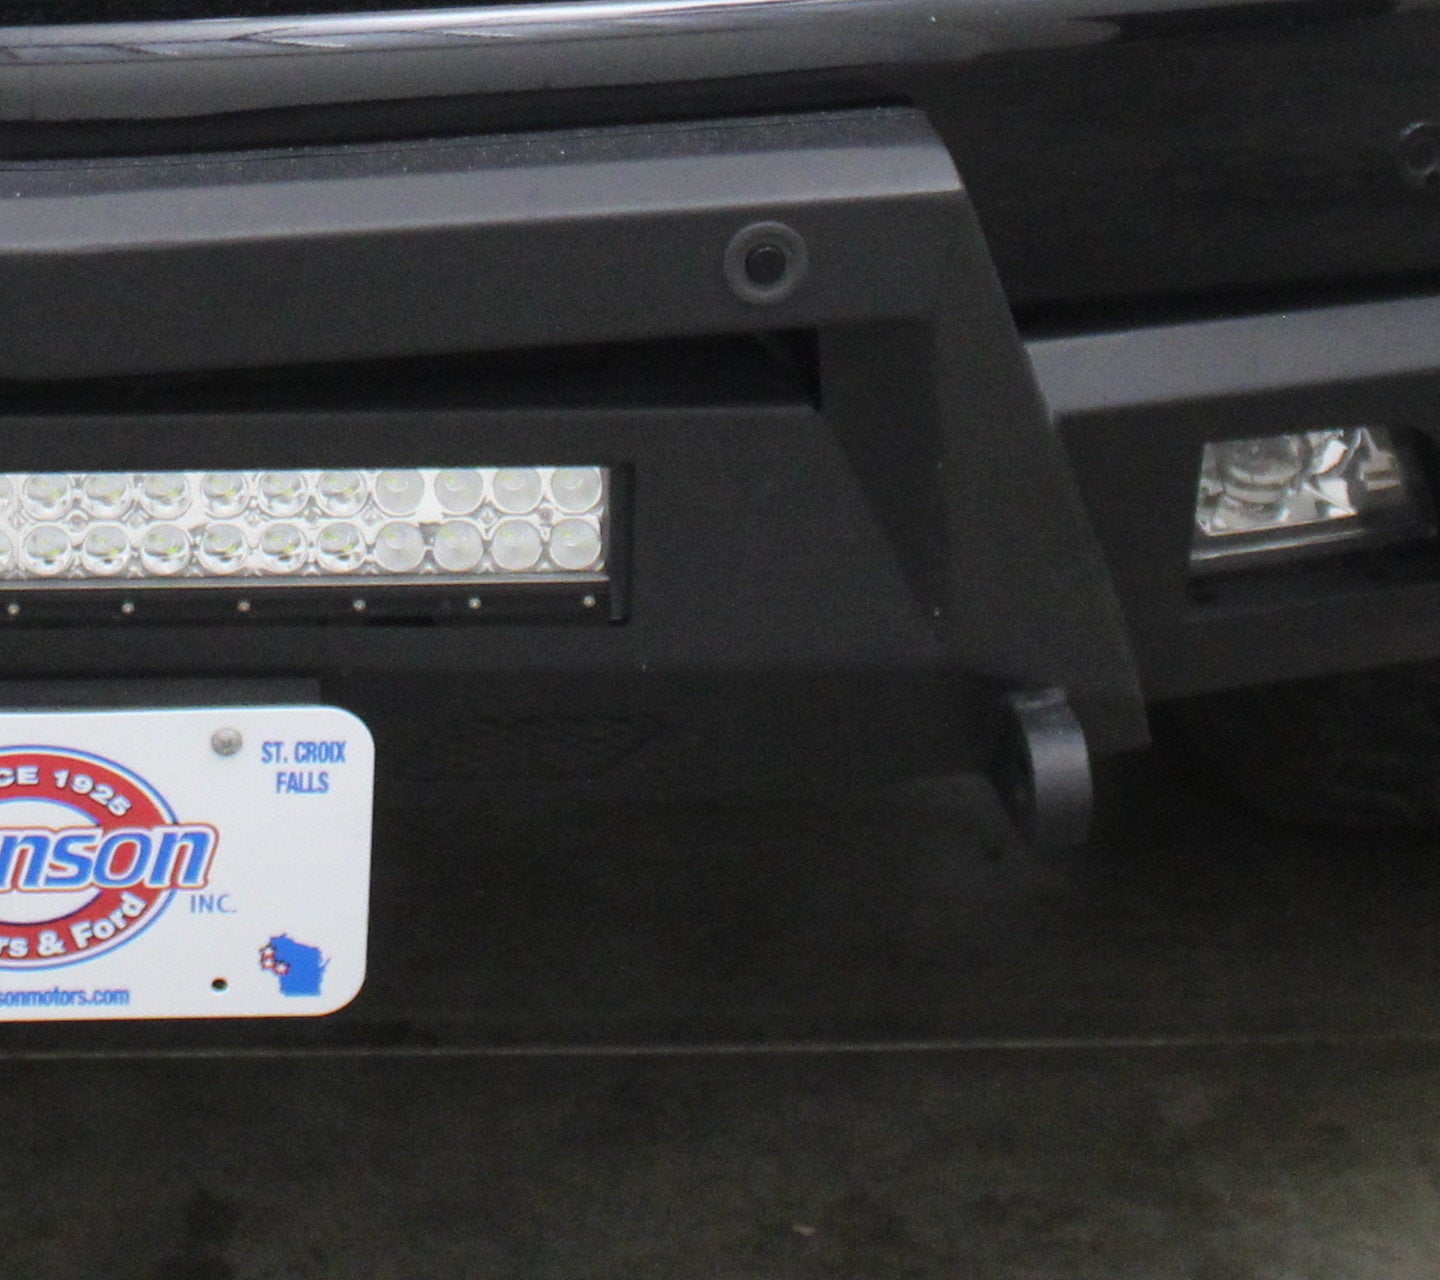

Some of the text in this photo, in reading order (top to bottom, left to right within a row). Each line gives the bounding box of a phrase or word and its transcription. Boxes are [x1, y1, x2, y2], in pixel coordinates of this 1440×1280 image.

[260, 740, 347, 764] ST. CROIX
[53, 769, 134, 817] 1925
[275, 771, 331, 795] FALLS
[189, 893, 238, 915] INC.
[36, 930, 66, 958] &
[70, 891, 149, 950] Ford
